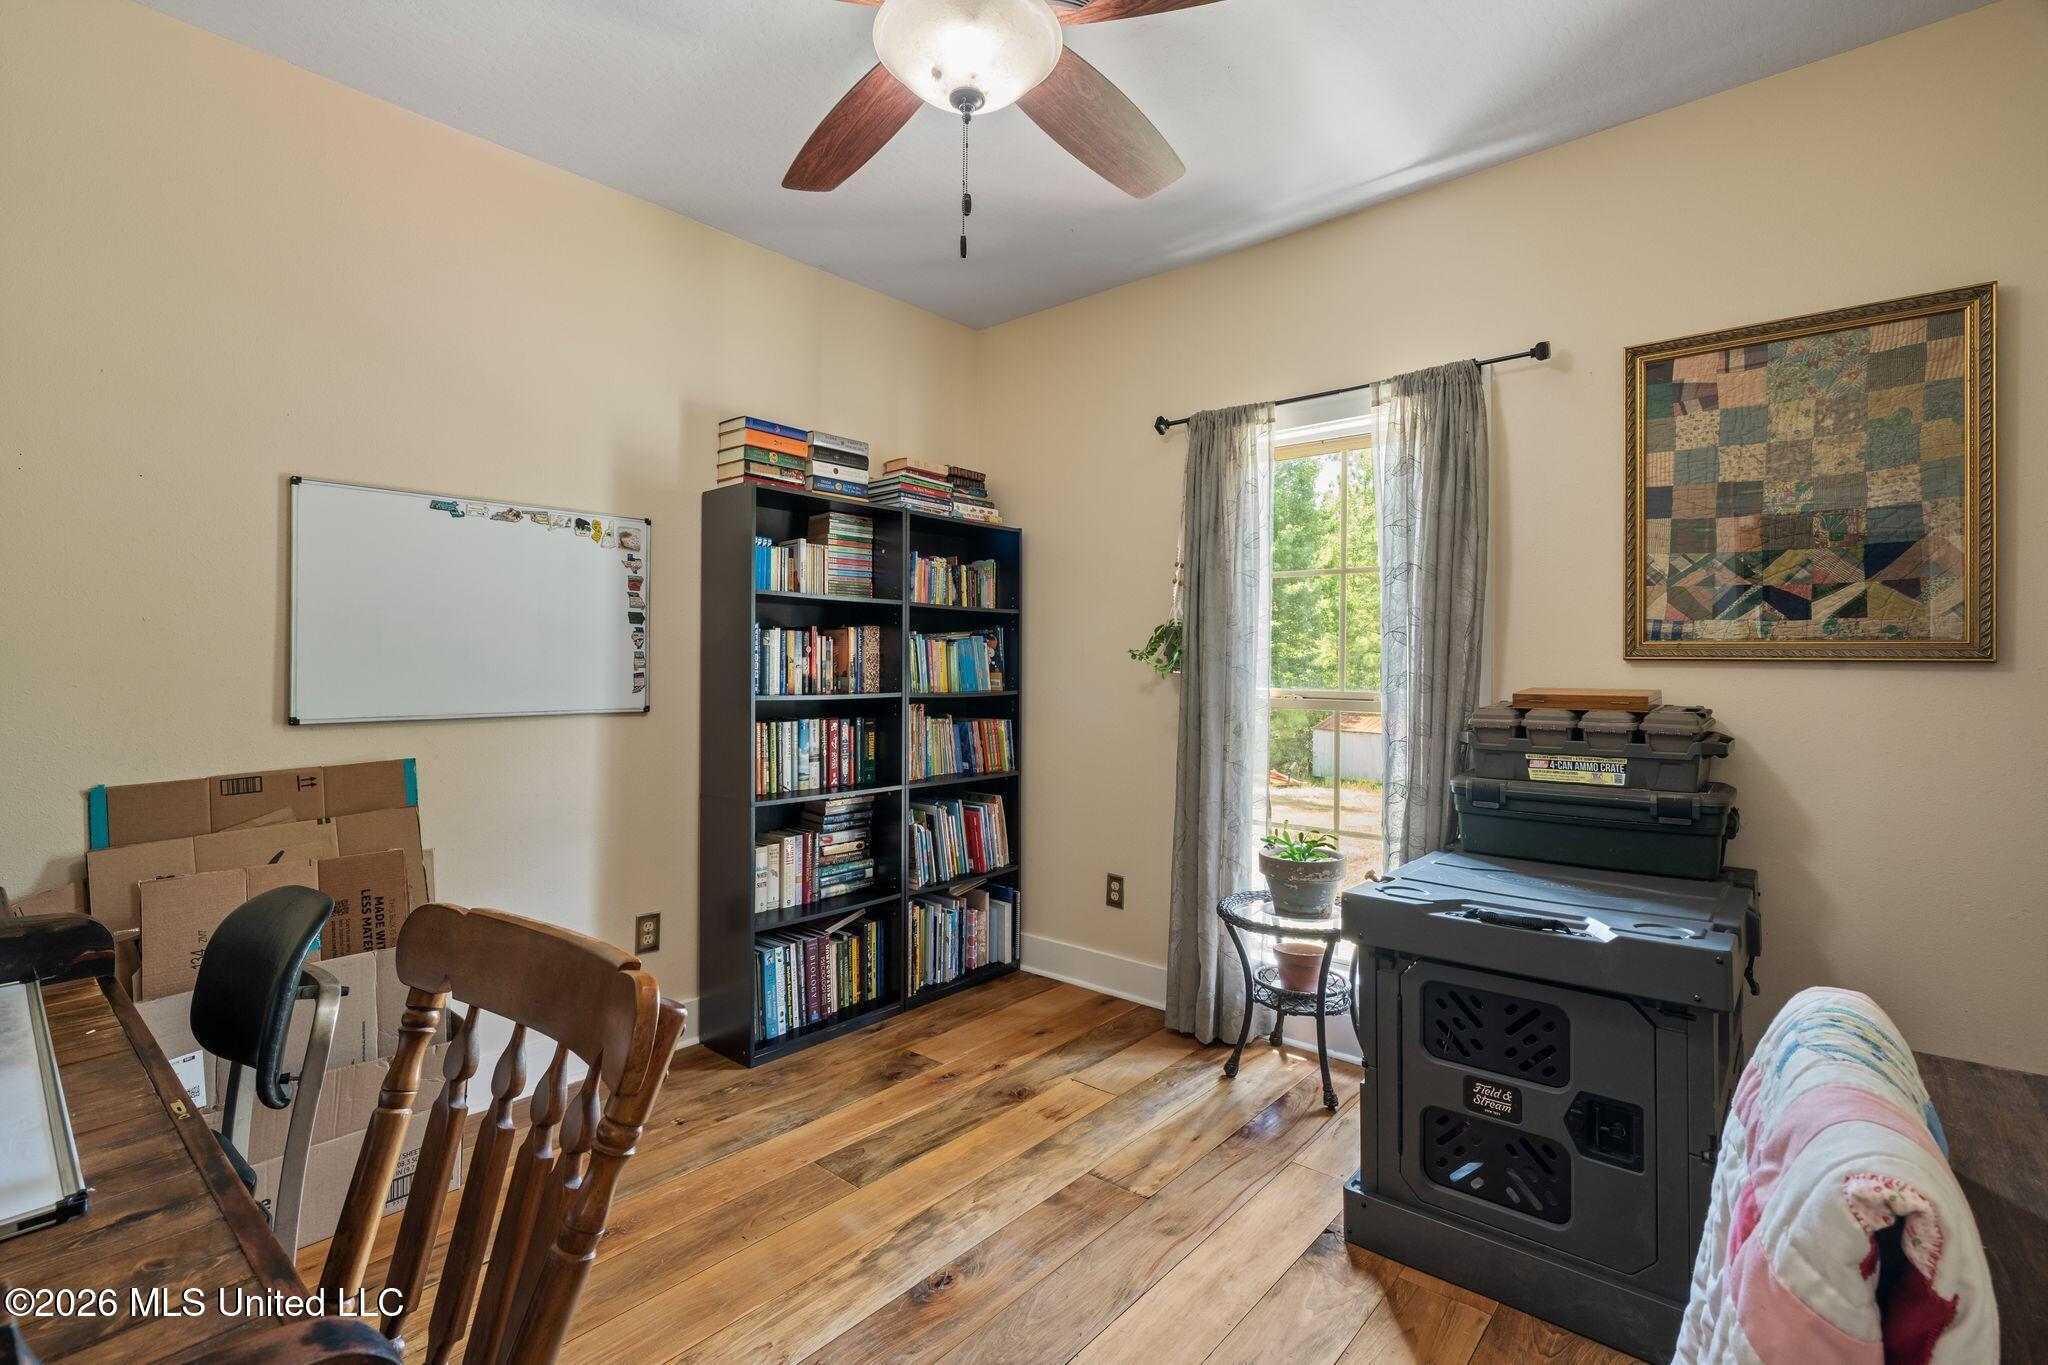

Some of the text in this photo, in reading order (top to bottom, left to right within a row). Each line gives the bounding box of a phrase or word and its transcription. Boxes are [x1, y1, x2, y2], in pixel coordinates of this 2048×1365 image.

[1549, 760, 1573, 770] 4-CAN
[1574, 762, 1599, 772] AMMO
[1600, 763, 1625, 773] CRATE
[361, 888, 374, 952] LESS MATER
[374, 896, 386, 950] MADE WIT
[1473, 1083, 1513, 1102] Field &
[1473, 1094, 1512, 1113] Stream
